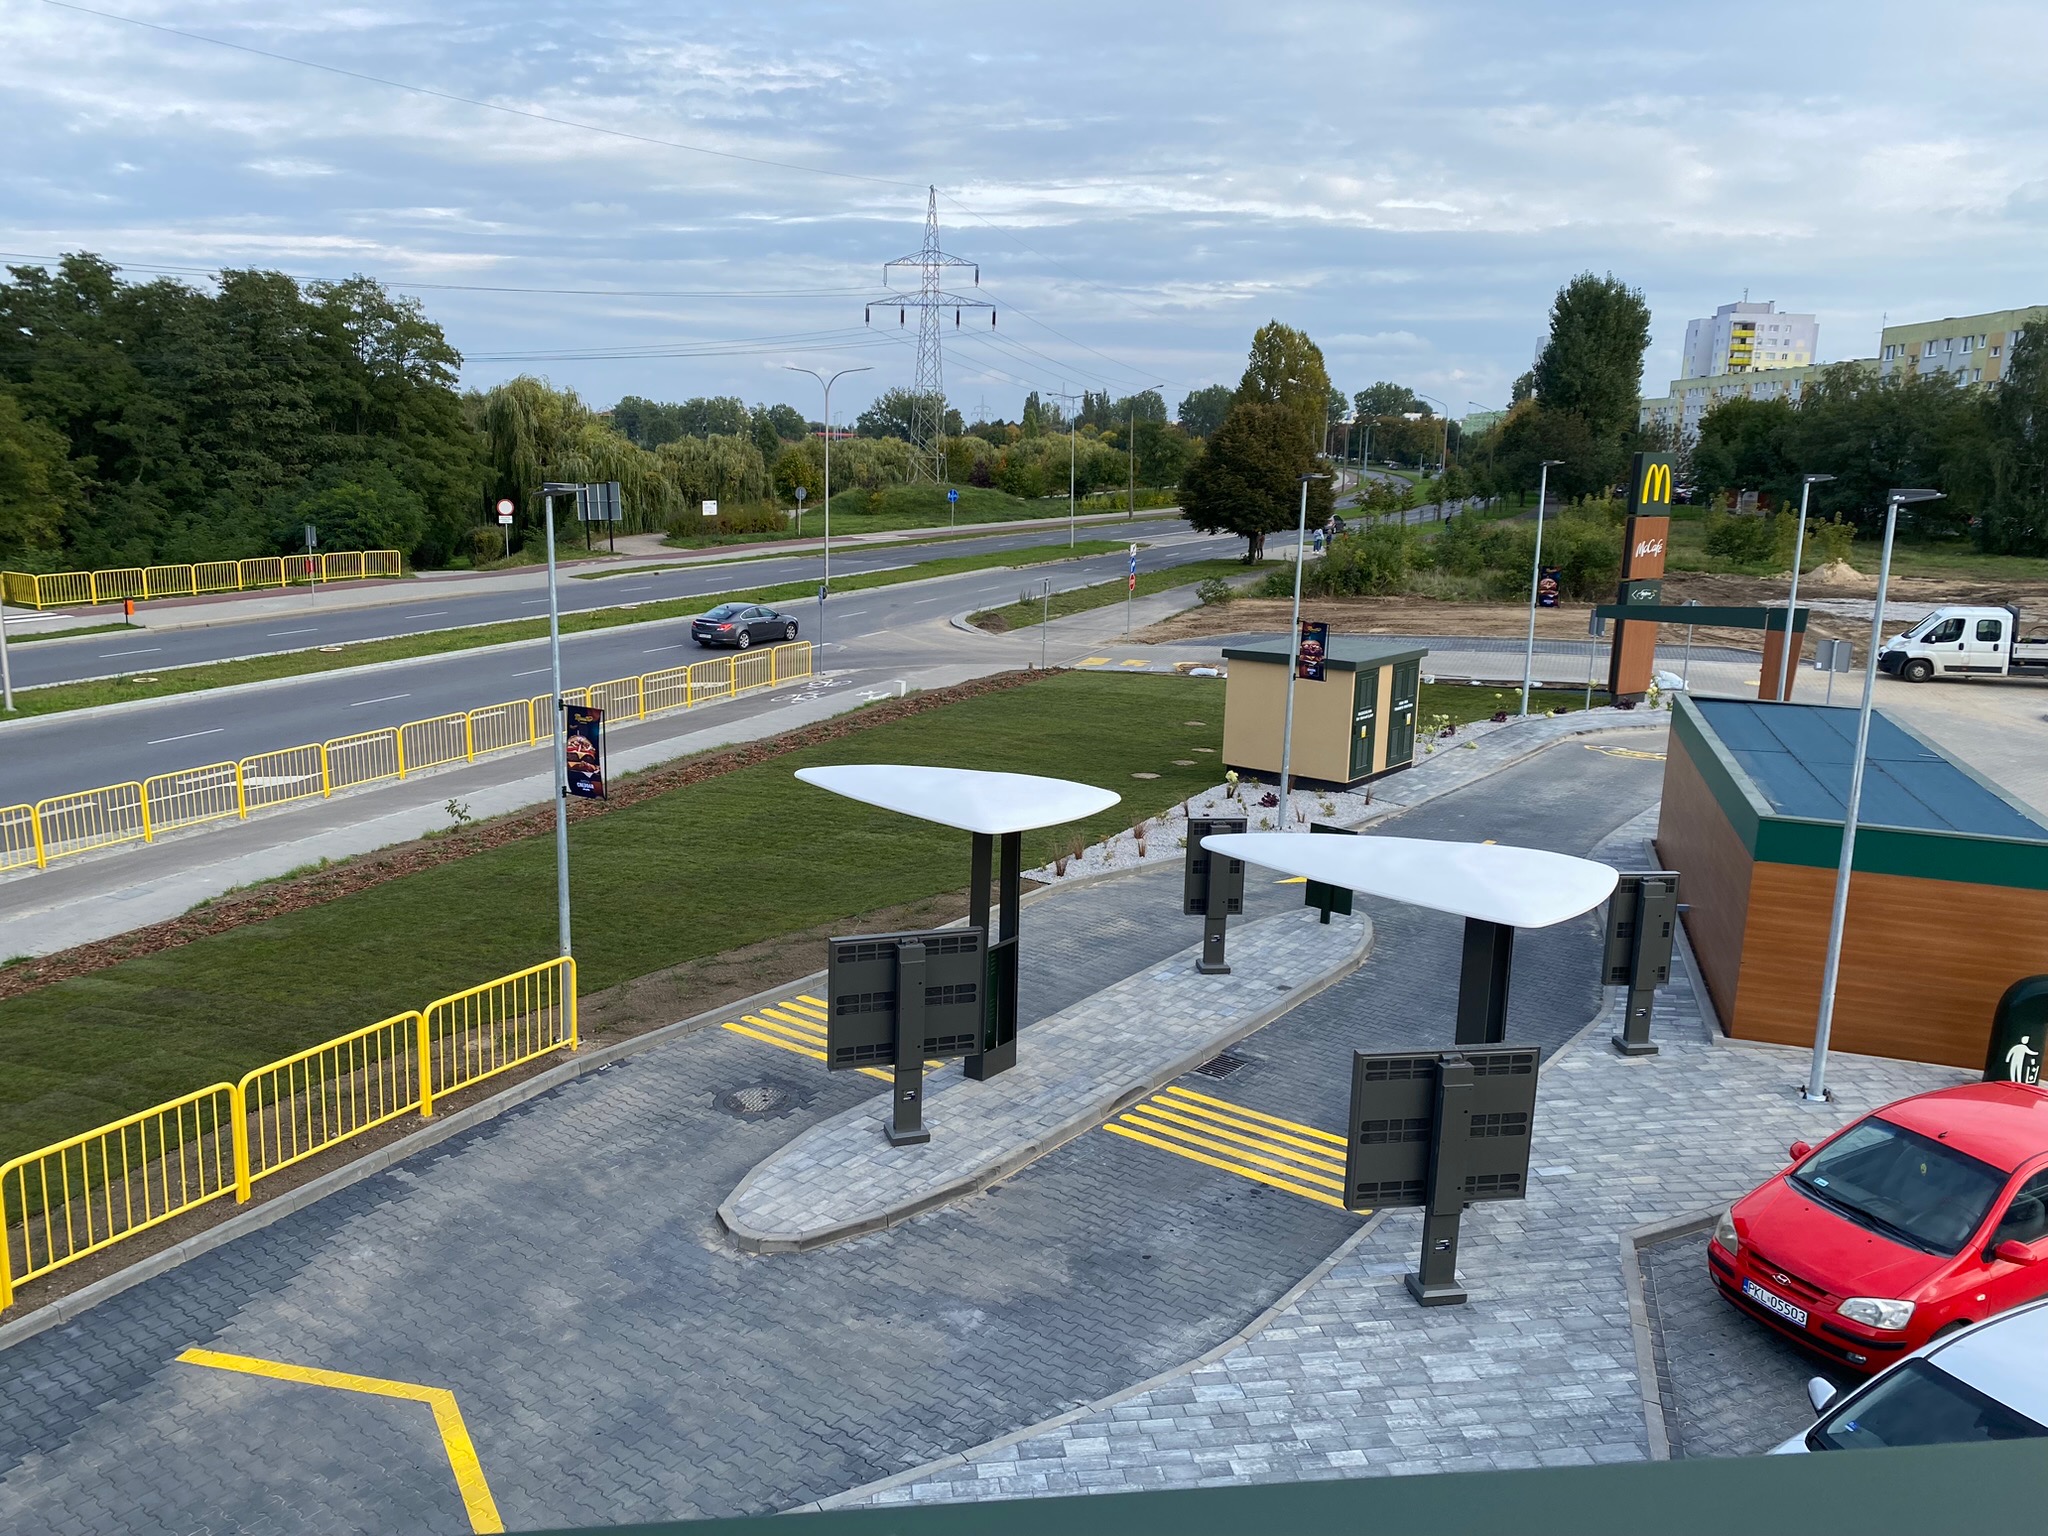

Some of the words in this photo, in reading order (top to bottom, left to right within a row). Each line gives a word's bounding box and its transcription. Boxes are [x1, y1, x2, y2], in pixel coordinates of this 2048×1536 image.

[1635, 538, 1663, 558] McCafé
[1748, 1282, 1766, 1303] PKL
[1770, 1296, 1806, 1323] 05503
